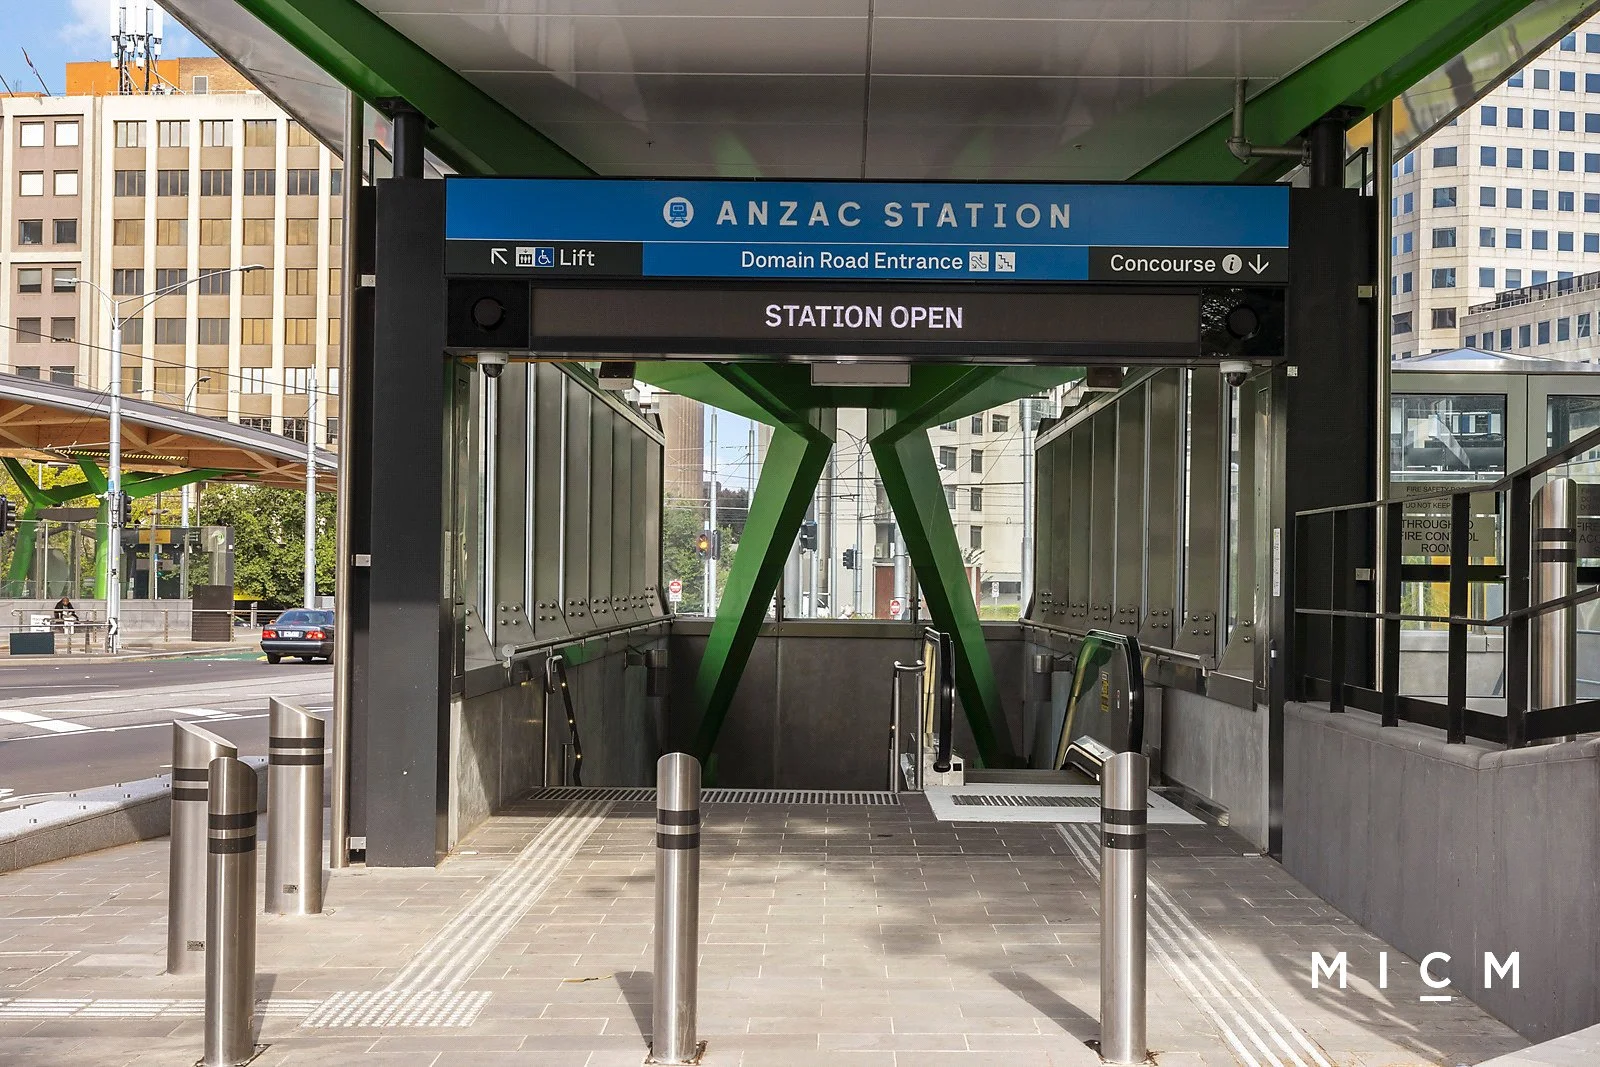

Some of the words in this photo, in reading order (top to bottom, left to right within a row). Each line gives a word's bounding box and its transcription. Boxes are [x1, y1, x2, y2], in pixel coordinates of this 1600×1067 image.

[716, 200, 862, 227] ANZAC
[884, 202, 1071, 229] STATION
[560, 248, 596, 268] Lift
[741, 250, 815, 270] Domain
[820, 251, 869, 270] Road
[874, 252, 963, 271] Entrance
[1110, 254, 1216, 273] Concourse
[764, 304, 884, 328] STATION
[890, 305, 964, 329] OPEN
